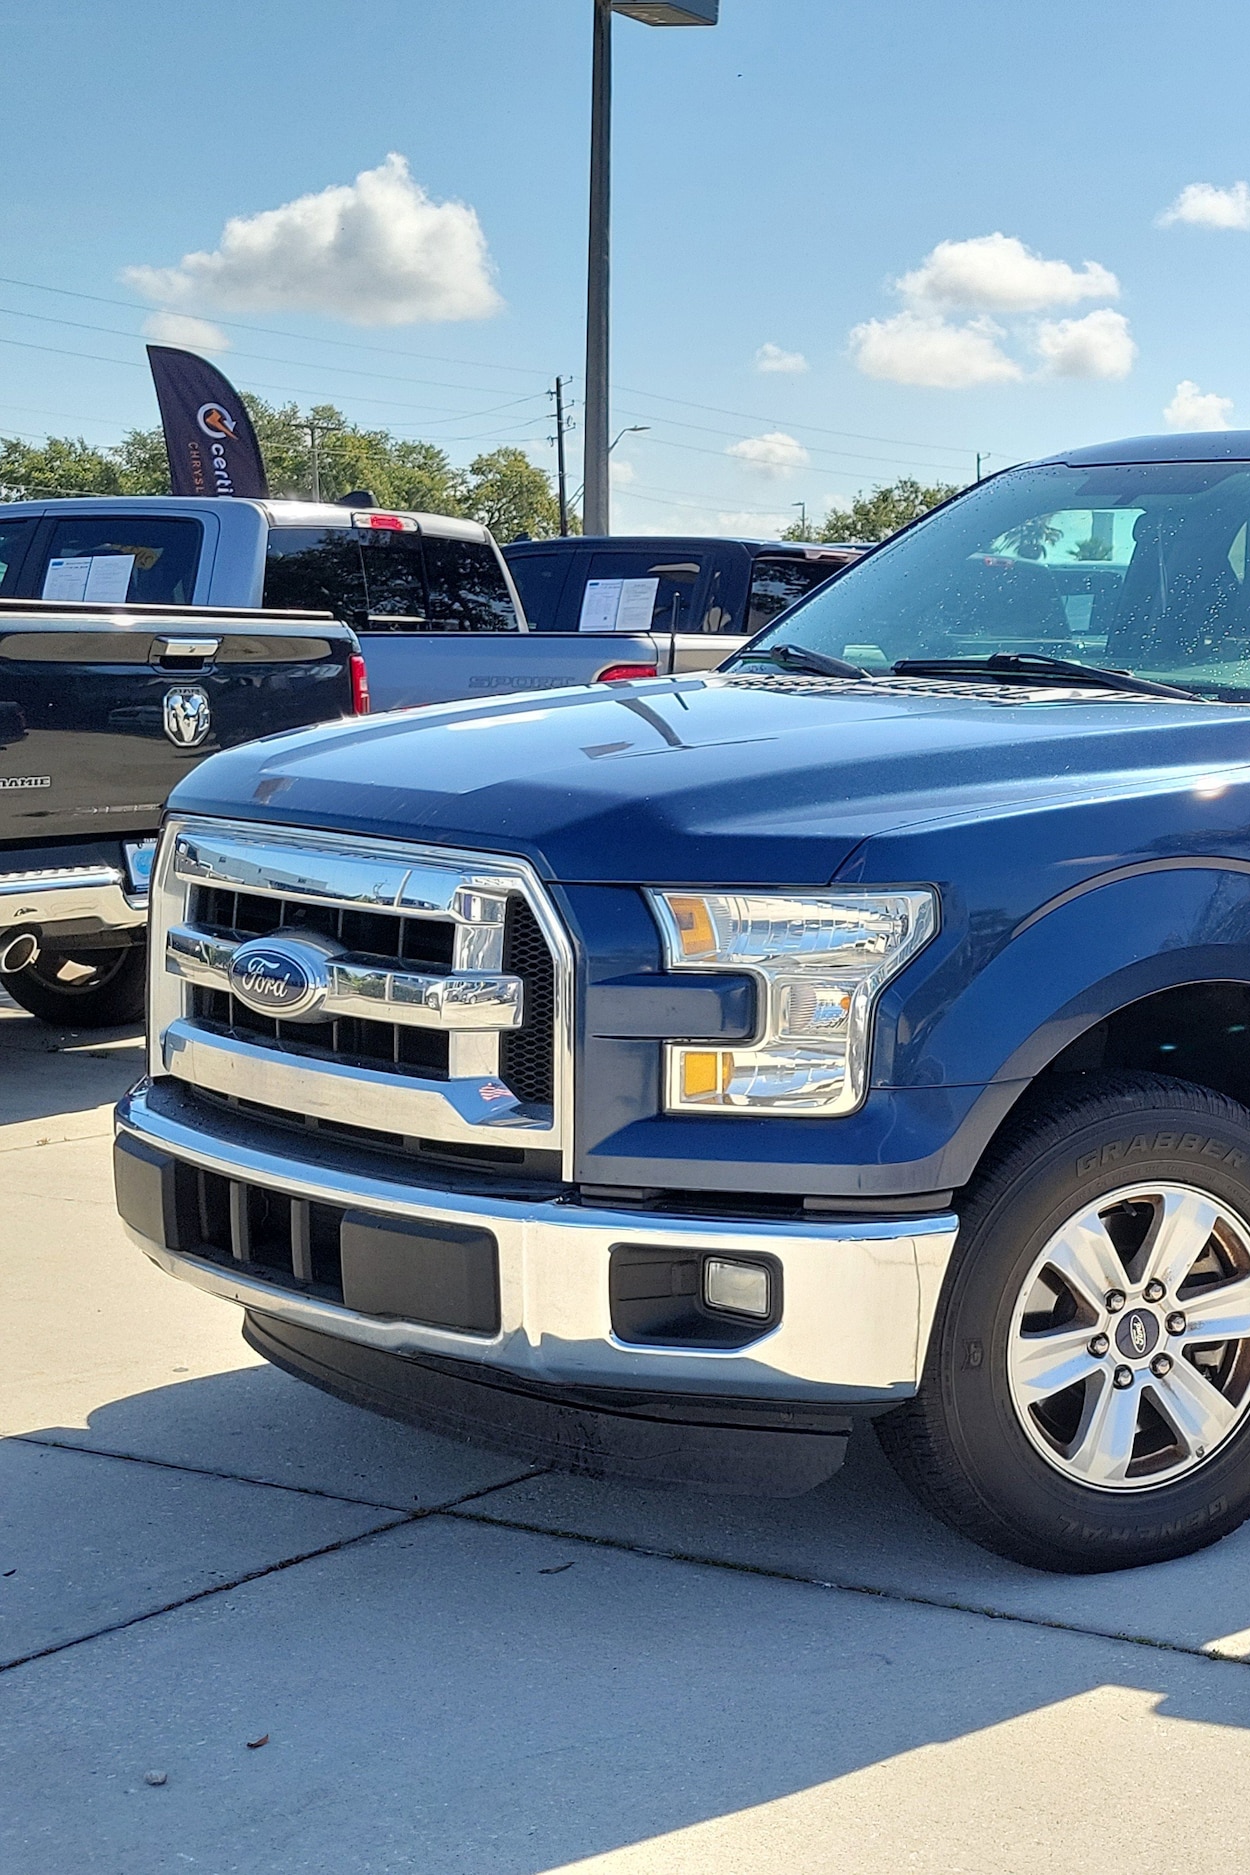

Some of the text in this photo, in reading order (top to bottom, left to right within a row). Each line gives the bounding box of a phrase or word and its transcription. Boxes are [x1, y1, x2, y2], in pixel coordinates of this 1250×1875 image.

[468, 675, 575, 690] SPORT
[242, 957, 290, 998] Ford
[1076, 1131, 1248, 1178] GRABBER
